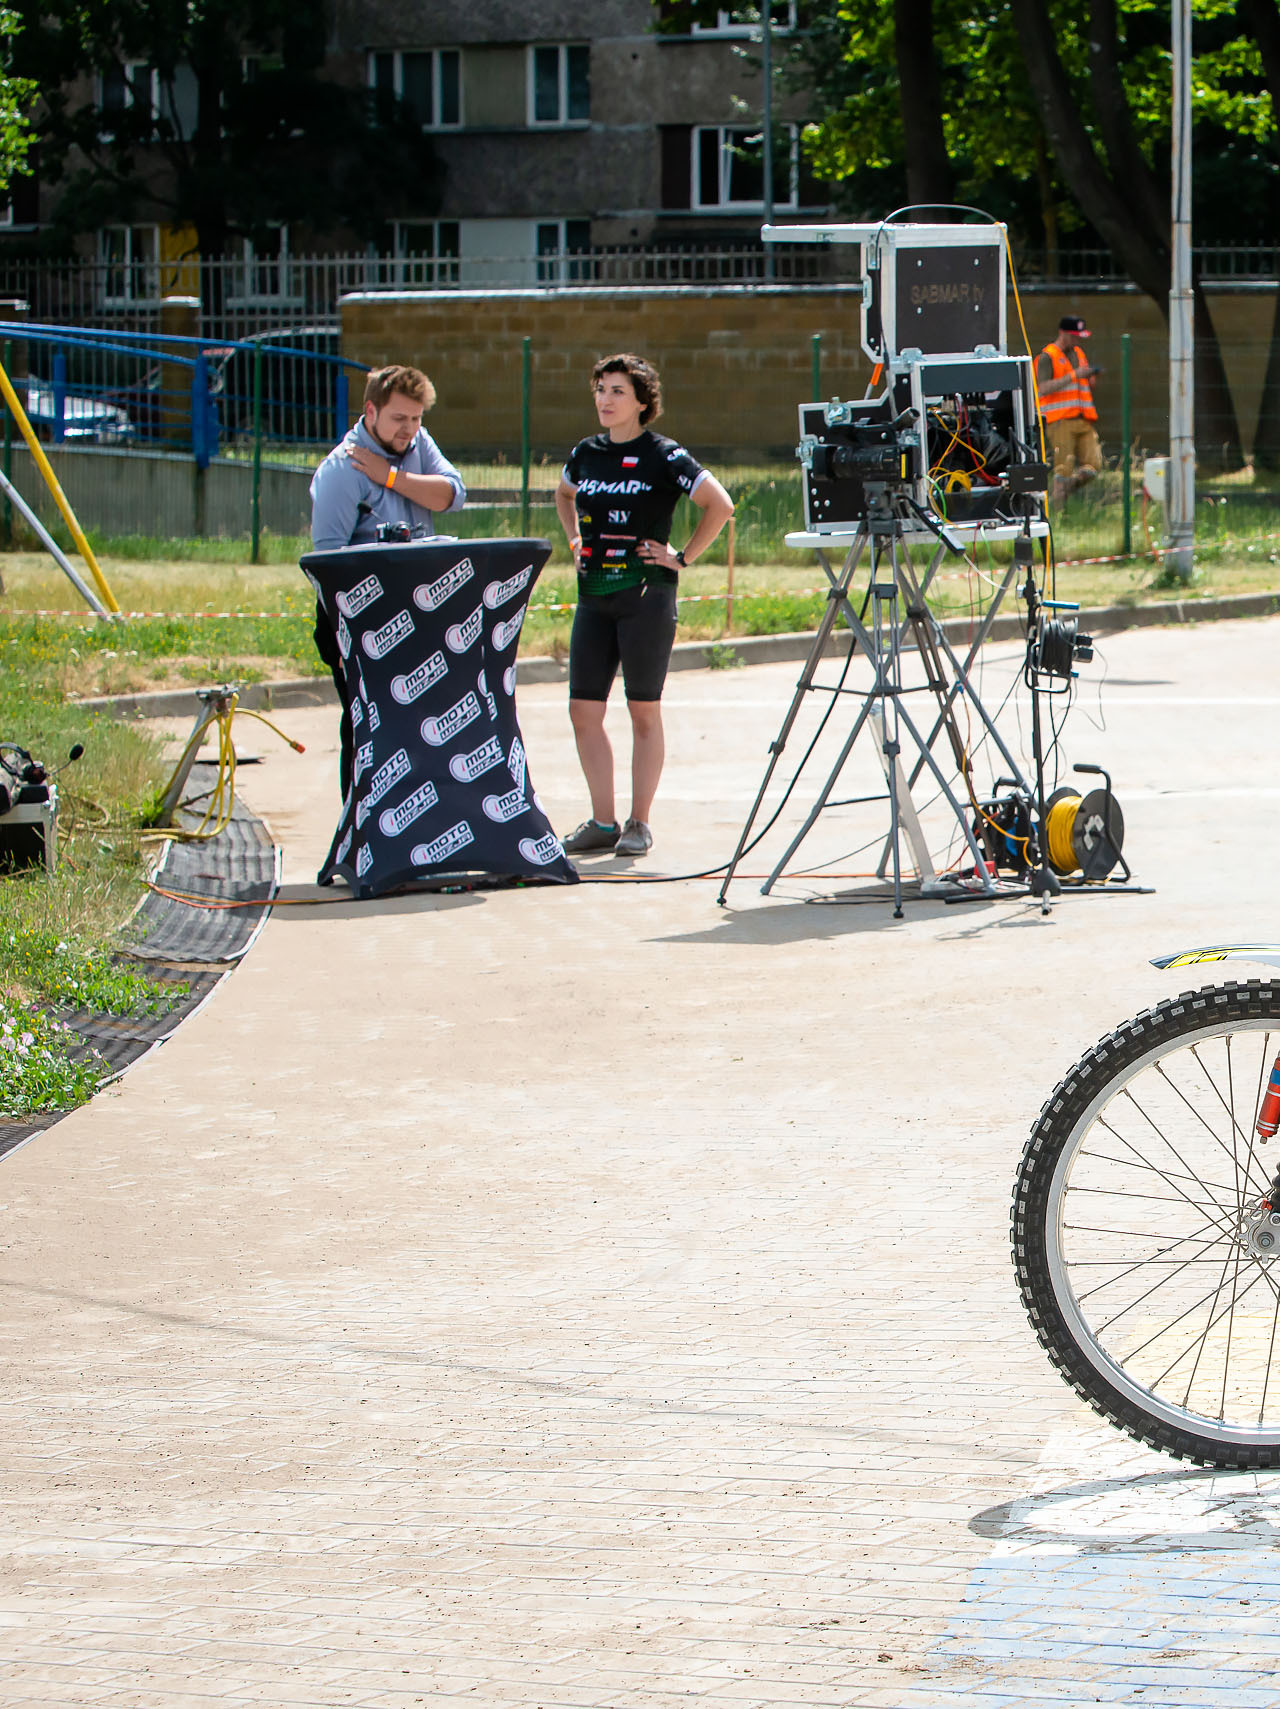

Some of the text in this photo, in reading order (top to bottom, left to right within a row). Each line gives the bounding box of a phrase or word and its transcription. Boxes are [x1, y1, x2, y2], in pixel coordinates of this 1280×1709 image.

[345, 577, 378, 605] MOTO
[428, 559, 470, 597] MOTO
[432, 567, 473, 606] WIZJA
[351, 585, 382, 613] WIZJA
[373, 611, 409, 645] MOTO
[378, 621, 414, 655] WIZJA
[405, 653, 443, 689] MOTO
[408, 662, 447, 699] WIZJA
[436, 694, 475, 730] MOTO
[440, 704, 480, 741] WIZJA
[394, 783, 432, 821] MOTO
[397, 792, 436, 831] WIZJA
[427, 823, 467, 855] MOTO
[431, 832, 472, 863] WIZJA
[535, 835, 555, 853] MO
